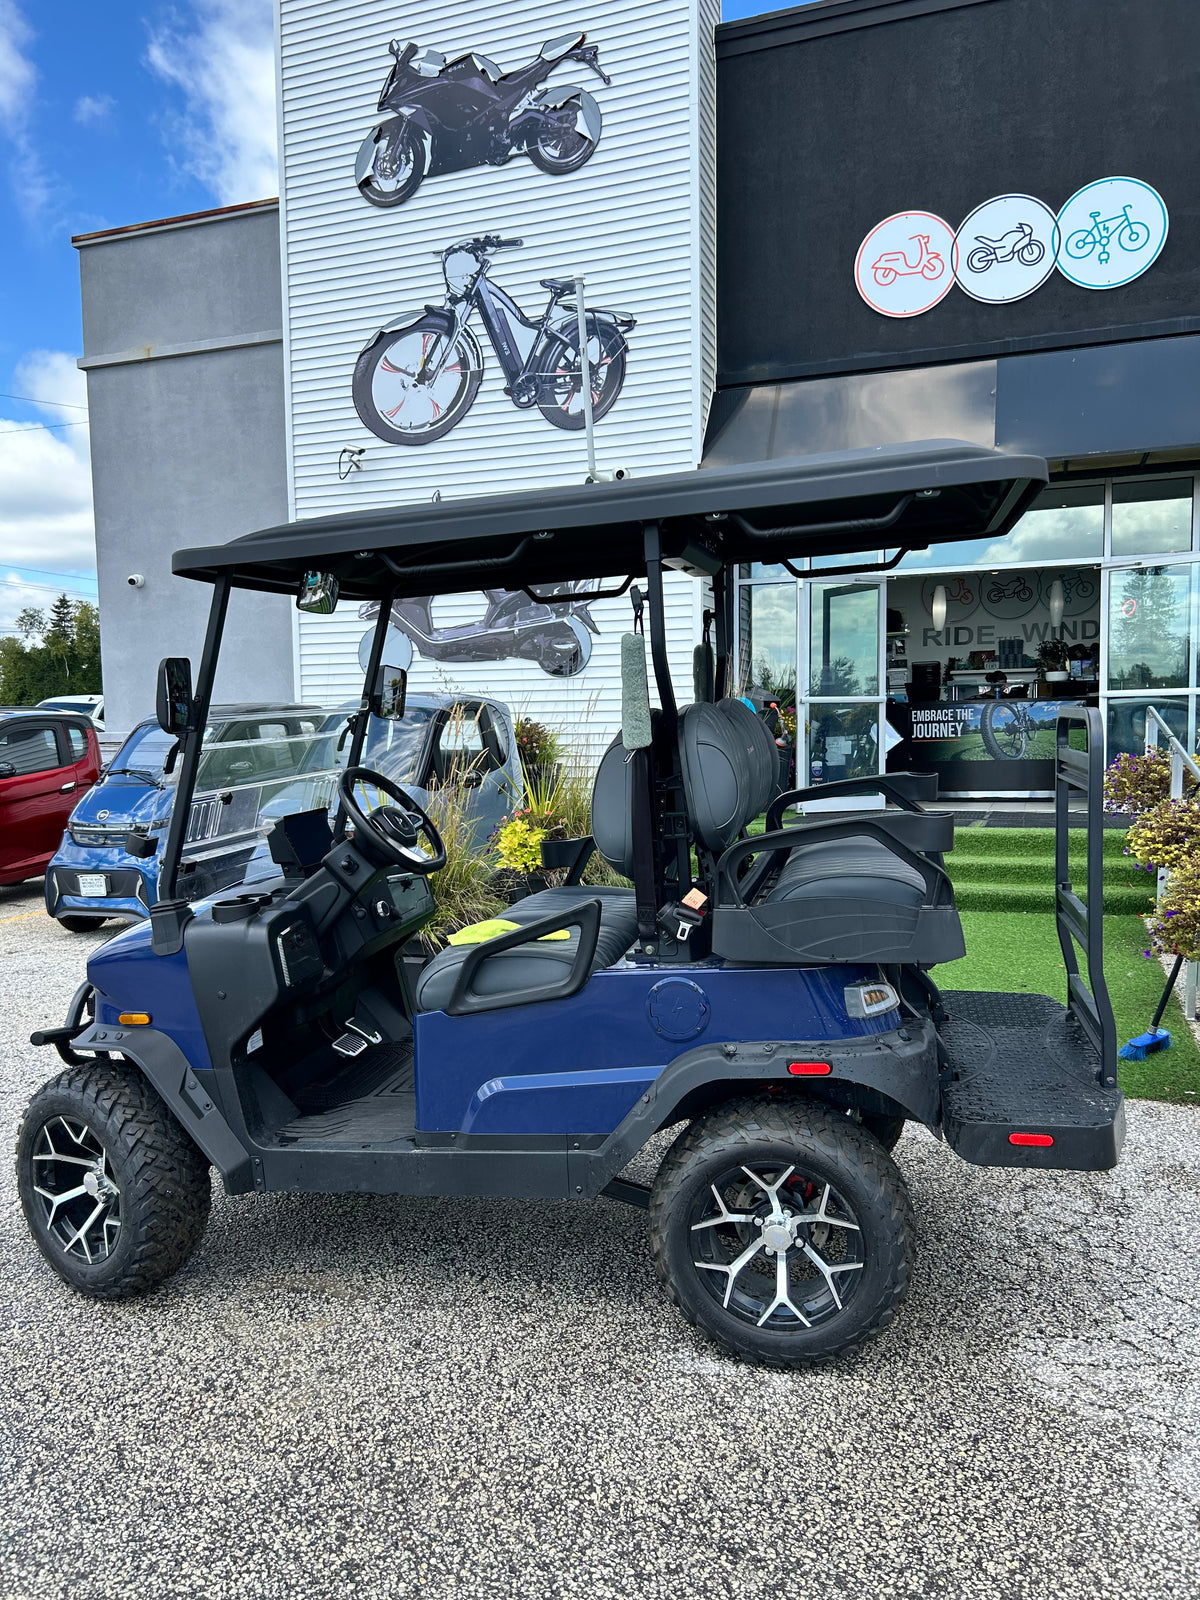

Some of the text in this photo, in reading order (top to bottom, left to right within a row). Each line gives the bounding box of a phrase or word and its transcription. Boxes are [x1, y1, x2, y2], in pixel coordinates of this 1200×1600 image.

[922, 625, 995, 647] RIDE
[1021, 620, 1100, 643] WIND
[911, 708, 975, 722] EMBRACE THE
[911, 722, 964, 738] JOURNEY
